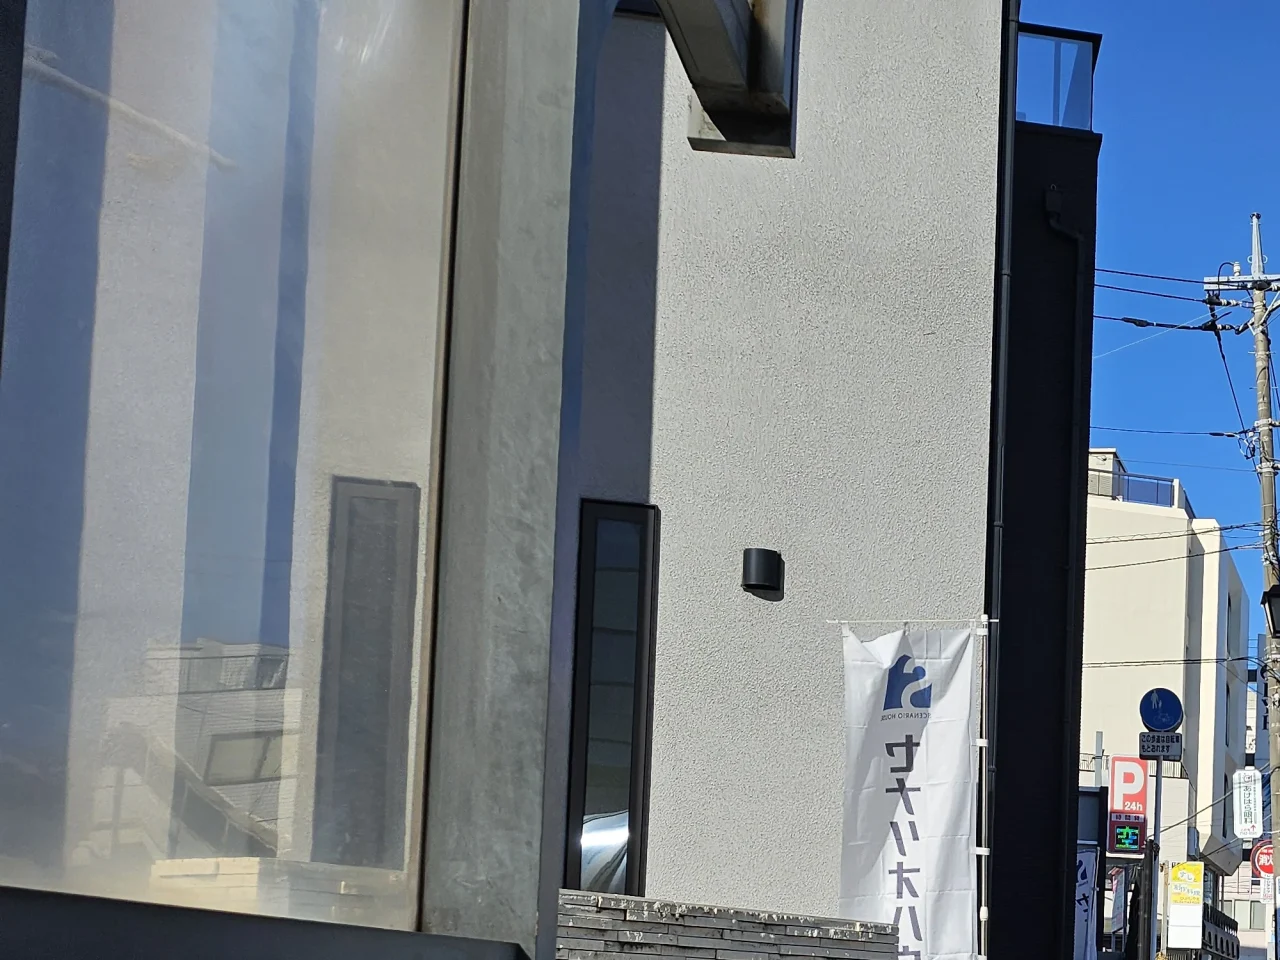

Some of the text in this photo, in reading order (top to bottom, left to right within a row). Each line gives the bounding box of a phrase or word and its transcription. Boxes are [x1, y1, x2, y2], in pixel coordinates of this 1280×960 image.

[1113, 760, 1145, 810] P
[1243, 785, 1253, 824] あけはら眼科
[1124, 801, 1143, 811] 24h
